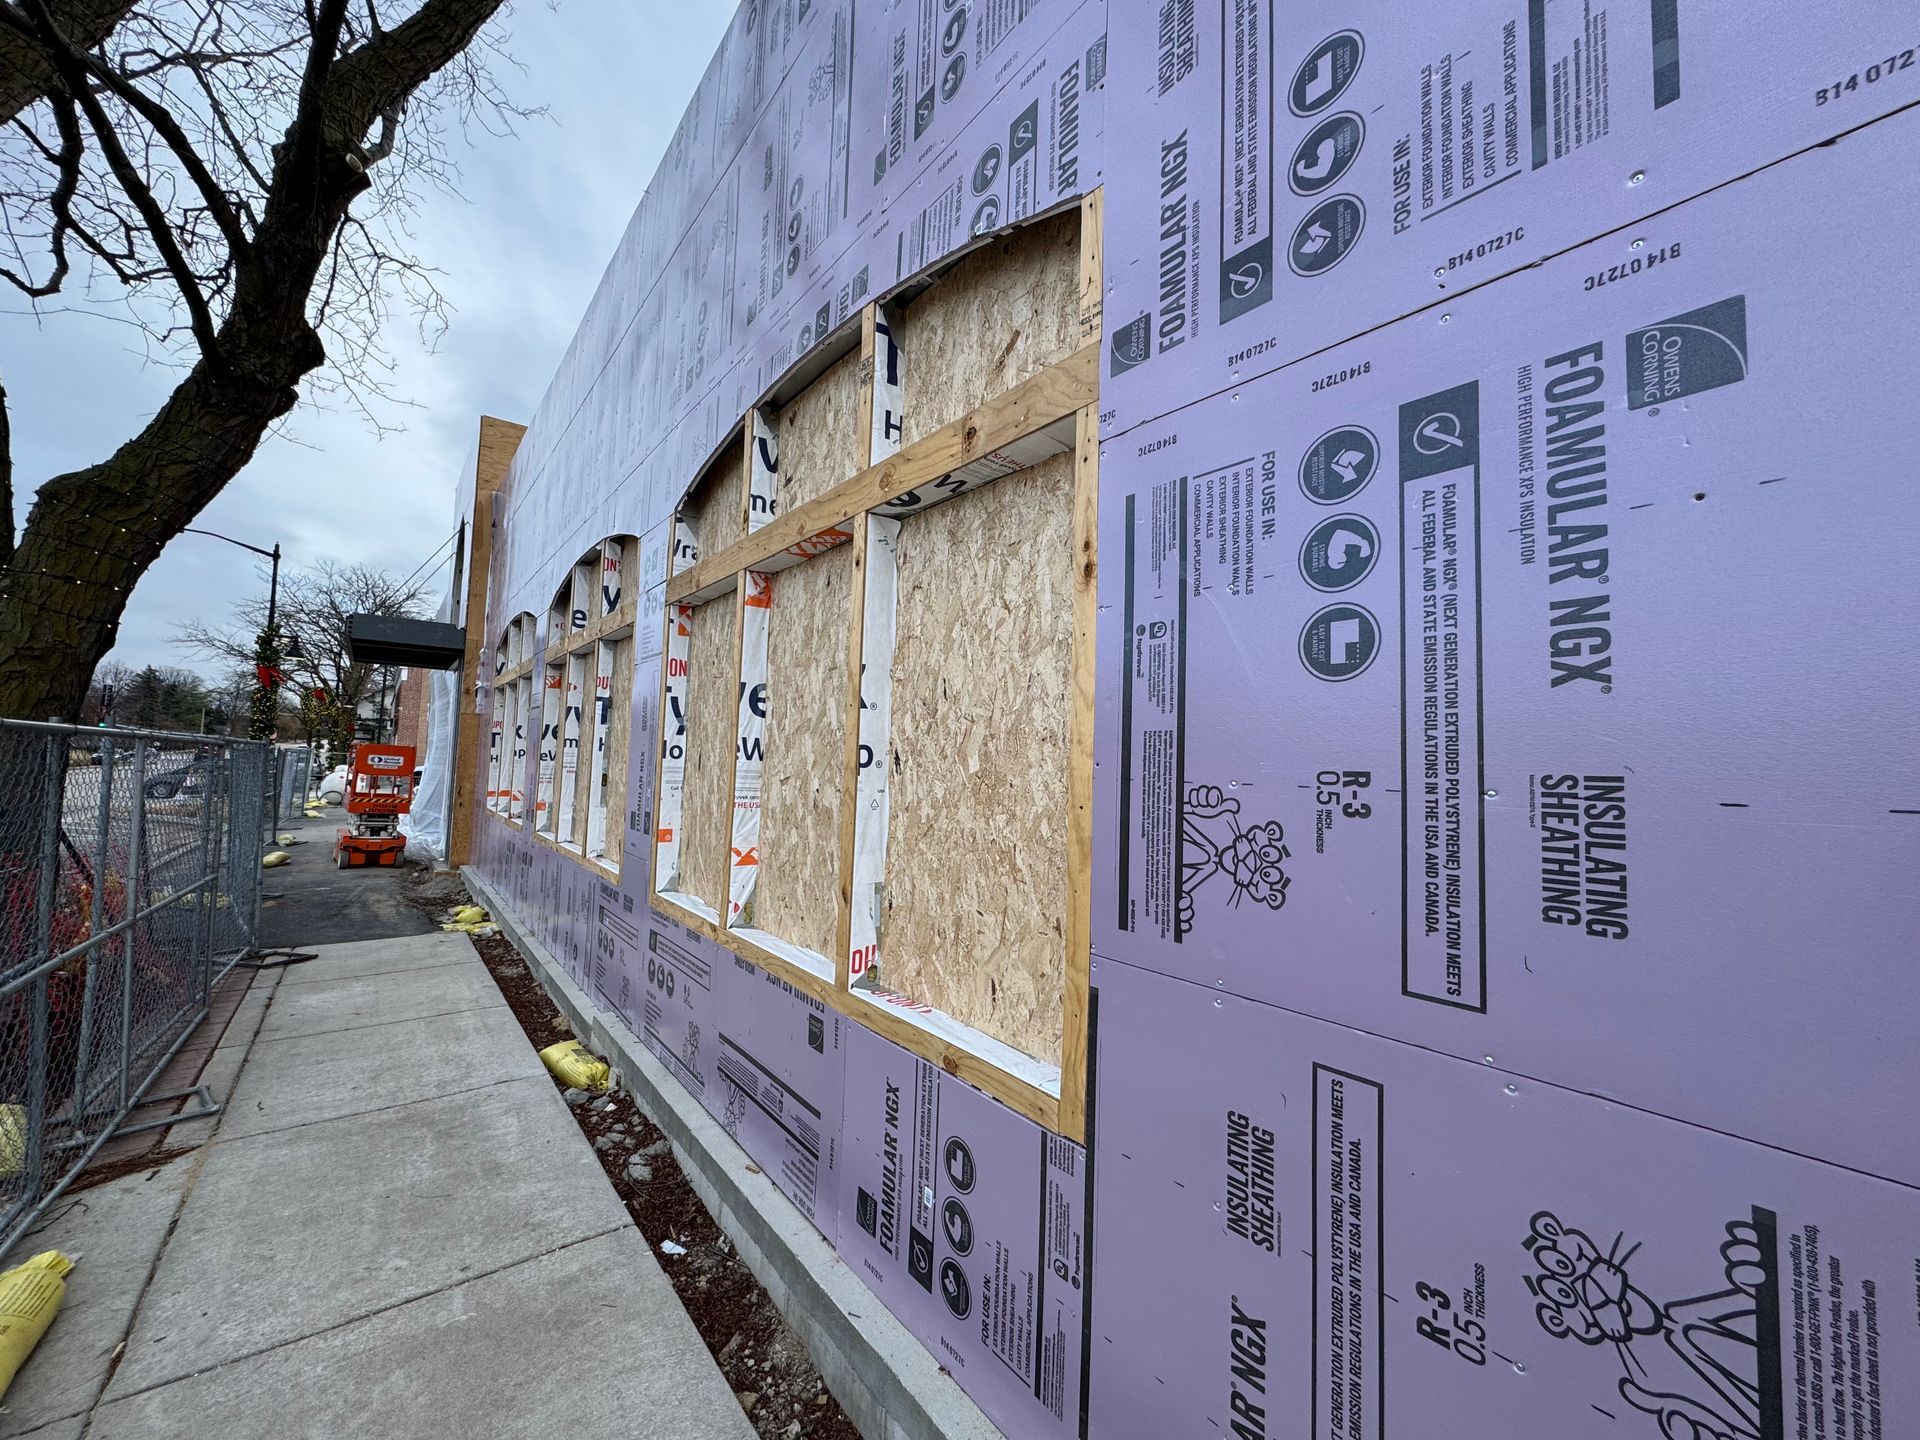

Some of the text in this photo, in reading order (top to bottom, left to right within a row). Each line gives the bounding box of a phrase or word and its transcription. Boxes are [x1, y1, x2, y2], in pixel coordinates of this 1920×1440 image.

[1176, 0, 1194, 82] SHEATHIN
[1234, 28, 1244, 77] EXTRUDED
[1234, 75, 1244, 134] GENERATION
[1247, 14, 1257, 236] ALL FEDERAL AND STATE EMISSION REGULATIONS
[1504, 20, 1518, 168] COMMERCIAL APPLICATIONS
[1814, 72, 1859, 107] B14
[1421, 64, 1433, 210] EXTERIOR FOUNDATION WALLS
[1441, 53, 1453, 201] INTERIOR FOUNDATION WALLS
[1461, 80, 1474, 190] EXTERIOR SHEATHING
[1483, 102, 1496, 179] CAVITY WALLS
[1394, 133, 1411, 236] FOR USE IN:
[1191, 199, 1200, 339] HIGH PERFORMANCE INSULATION
[1447, 226, 1525, 271] B14 0727C
[1583, 241, 1682, 293] B14 0727C
[1228, 336, 1277, 368] B14 0727C
[1311, 360, 1372, 393] B14 0727C
[1641, 330, 1660, 403] CORNING
[1662, 335, 1682, 397] OWENS
[1162, 434, 1178, 449] B14
[1517, 364, 1536, 566] HIGH PERFORMANCE XPS INSULATION
[1206, 480, 1214, 539] CAVITY WALLS
[1219, 475, 1227, 565] EXTERIOR SHEATHING
[1246, 467, 1254, 595] EXTERIOR FOUNDATION WALLS
[1262, 450, 1275, 541] FOR USE IN:
[1193, 483, 1201, 598] COMMERCIAL APPLICATIONS
[1232, 472, 1240, 596] INTERIOR FOUNDATION WALLS
[1440, 593, 1458, 630] (NEXT
[1444, 632, 1459, 710] GENERATION
[1422, 489, 1439, 938] ALL FEDERAL AND STATE EMISSION REGULATIONS IN THE USA AND CANADA.
[1445, 712, 1460, 776] EXTRUDED
[1315, 770, 1341, 806] 0.5
[1324, 809, 1333, 830] INCH
[1342, 770, 1372, 820] R-3
[1315, 808, 1324, 854] THICKNESS
[1443, 778, 1461, 871] POLYSTYRENE)
[1540, 774, 1582, 926] SHEATHING
[1583, 775, 1629, 940] INSULATING
[1446, 871, 1461, 949] INSULATION
[1446, 950, 1462, 998] MEETS
[1227, 1110, 1250, 1240] INSULATING
[1251, 1126, 1275, 1253] SHEATHING
[1349, 1137, 1361, 1193] CANADA.
[1349, 1192, 1361, 1222] AND
[1349, 1221, 1361, 1249] USA
[1330, 1079, 1345, 1431] GENERATION EXTRUDED POLYSTYRENE) INSULATION MEETS
[1349, 1247, 1361, 1275] THE
[1349, 1276, 1361, 1291] IN
[1789, 1242, 1807, 1323] required specified
[982, 1273, 991, 1347] FOR USE IN:
[1416, 1280, 1451, 1351] R-3
[1463, 1288, 1474, 1316] INCH
[1475, 1262, 1486, 1320] THICKNESS
[1349, 1290, 1361, 1379] REGULATIONS
[1453, 1312, 1486, 1366] 0.5
[1810, 1356, 1822, 1374] call
[1830, 1345, 1846, 1373] higher
[1831, 1371, 1844, 1387] The
